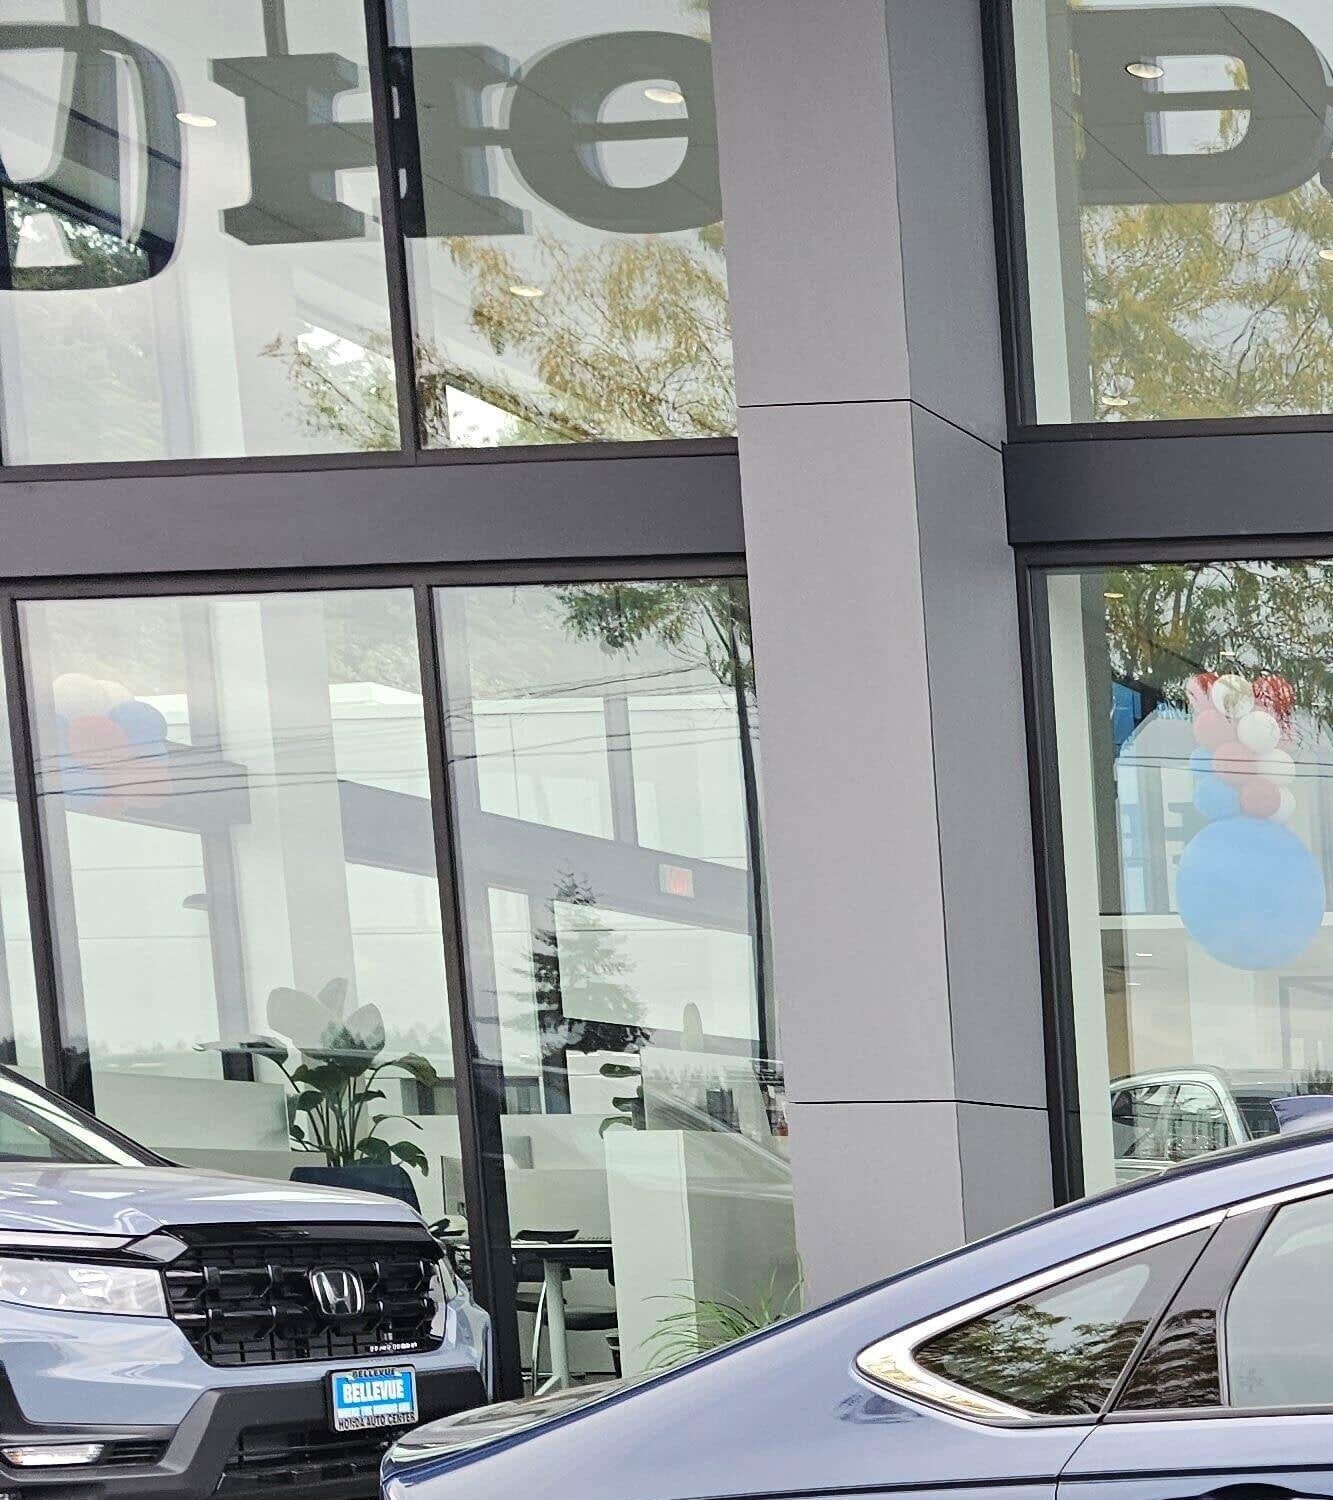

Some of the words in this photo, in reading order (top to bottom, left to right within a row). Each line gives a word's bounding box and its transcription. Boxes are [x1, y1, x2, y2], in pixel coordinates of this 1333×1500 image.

[342, 1379, 405, 1404] BELLEVUE
[366, 1414, 386, 1427] AUTO
[387, 1411, 417, 1425] CENTER
